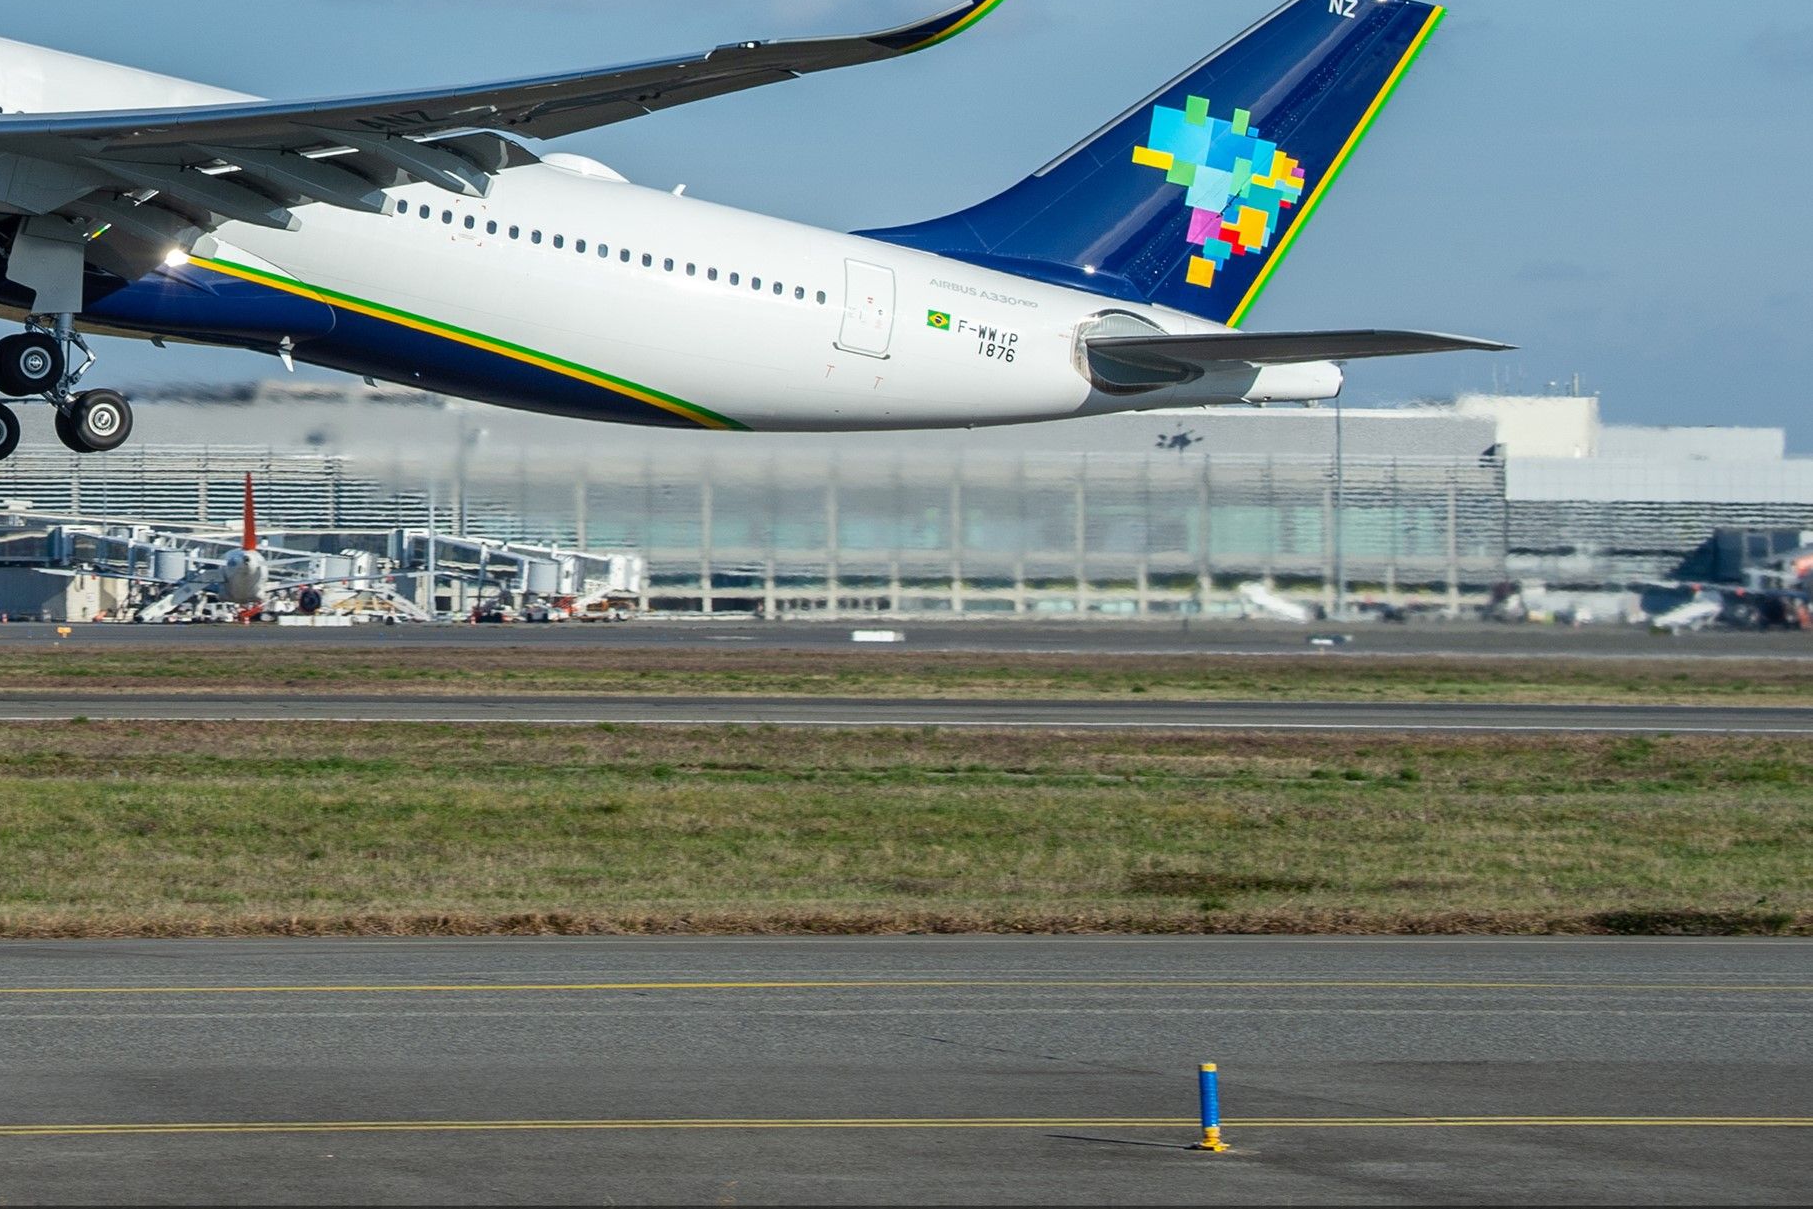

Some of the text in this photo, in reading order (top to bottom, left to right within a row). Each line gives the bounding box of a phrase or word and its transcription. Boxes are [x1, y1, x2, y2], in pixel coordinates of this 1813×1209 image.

[929, 278, 978, 296] AIRBUS
[957, 320, 1019, 347] F-WWYP
[978, 341, 1016, 363] 1876
